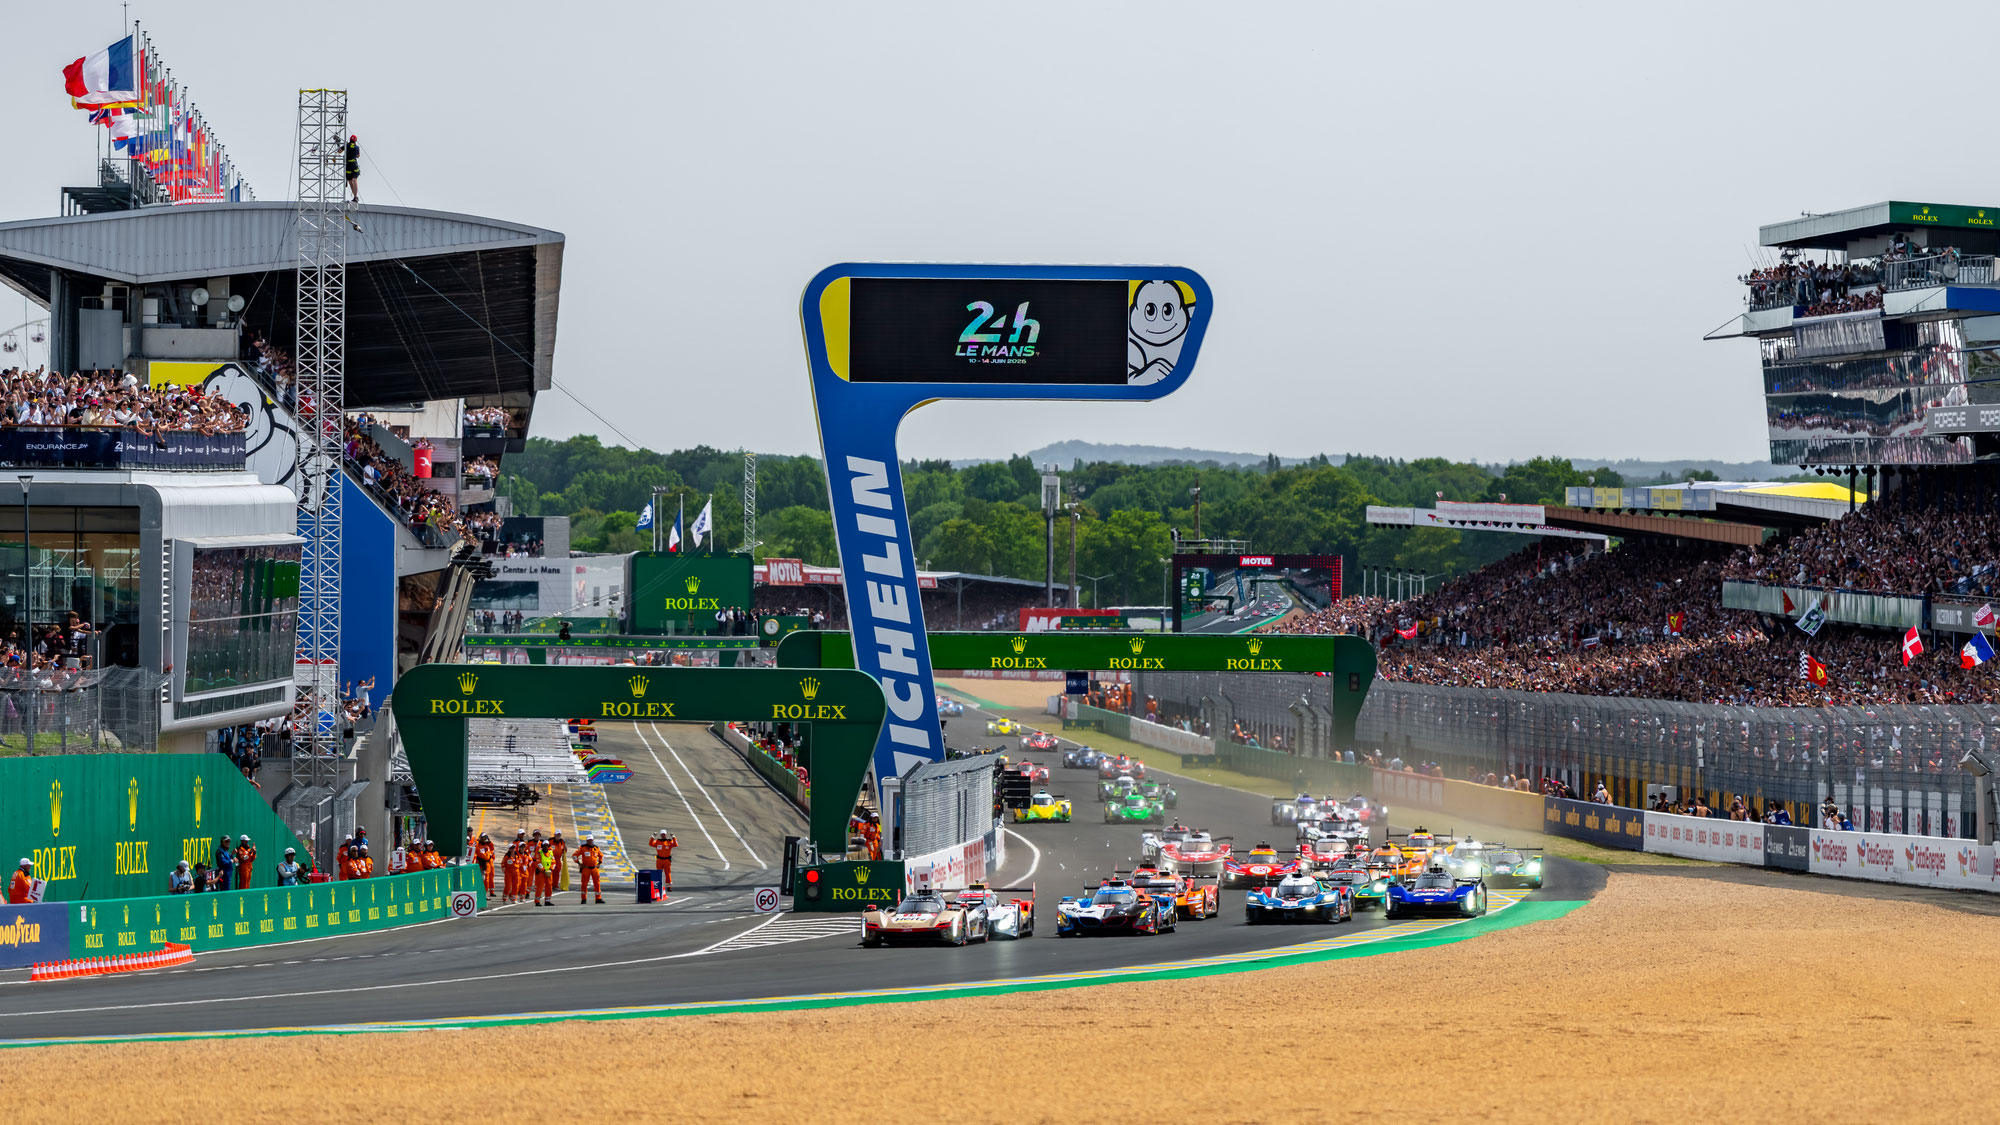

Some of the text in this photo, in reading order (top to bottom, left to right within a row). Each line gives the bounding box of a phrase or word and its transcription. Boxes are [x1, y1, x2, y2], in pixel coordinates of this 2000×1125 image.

[1913, 214, 1938, 222] ROLEX
[1968, 218, 1994, 226] ROLEX
[955, 345, 1036, 357] LE MANS
[1934, 411, 1966, 428] PORSCHE
[1242, 557, 1273, 565] MOTUL
[502, 565, 527, 574] Center
[540, 565, 561, 574] Mans
[769, 562, 803, 582] MOTUL
[666, 598, 719, 609] ROLEX
[992, 657, 1046, 668] ROLEX
[1110, 658, 1164, 668] ROLEX
[1228, 659, 1282, 669] ROLEX
[432, 700, 504, 713] ROLEX
[602, 702, 675, 716] ROLEX
[773, 705, 846, 719] ROLEX
[116, 842, 148, 875] ROLEX
[183, 837, 212, 870] ROLEX
[1821, 838, 1848, 867] TotalEnergies
[1866, 842, 1895, 872] TotalEnergies
[1915, 846, 1946, 877] TotalEnergies
[34, 846, 76, 881] ROLEX
[833, 888, 891, 899] ROLEX
[456, 900, 471, 910] 60
[759, 895, 775, 905] 60
[85, 934, 103, 948] ROLEX
[118, 932, 136, 946] ROLEX
[150, 929, 167, 943] ROLEX
[180, 927, 197, 941] ROLEX
[208, 924, 224, 938] ROLEX
